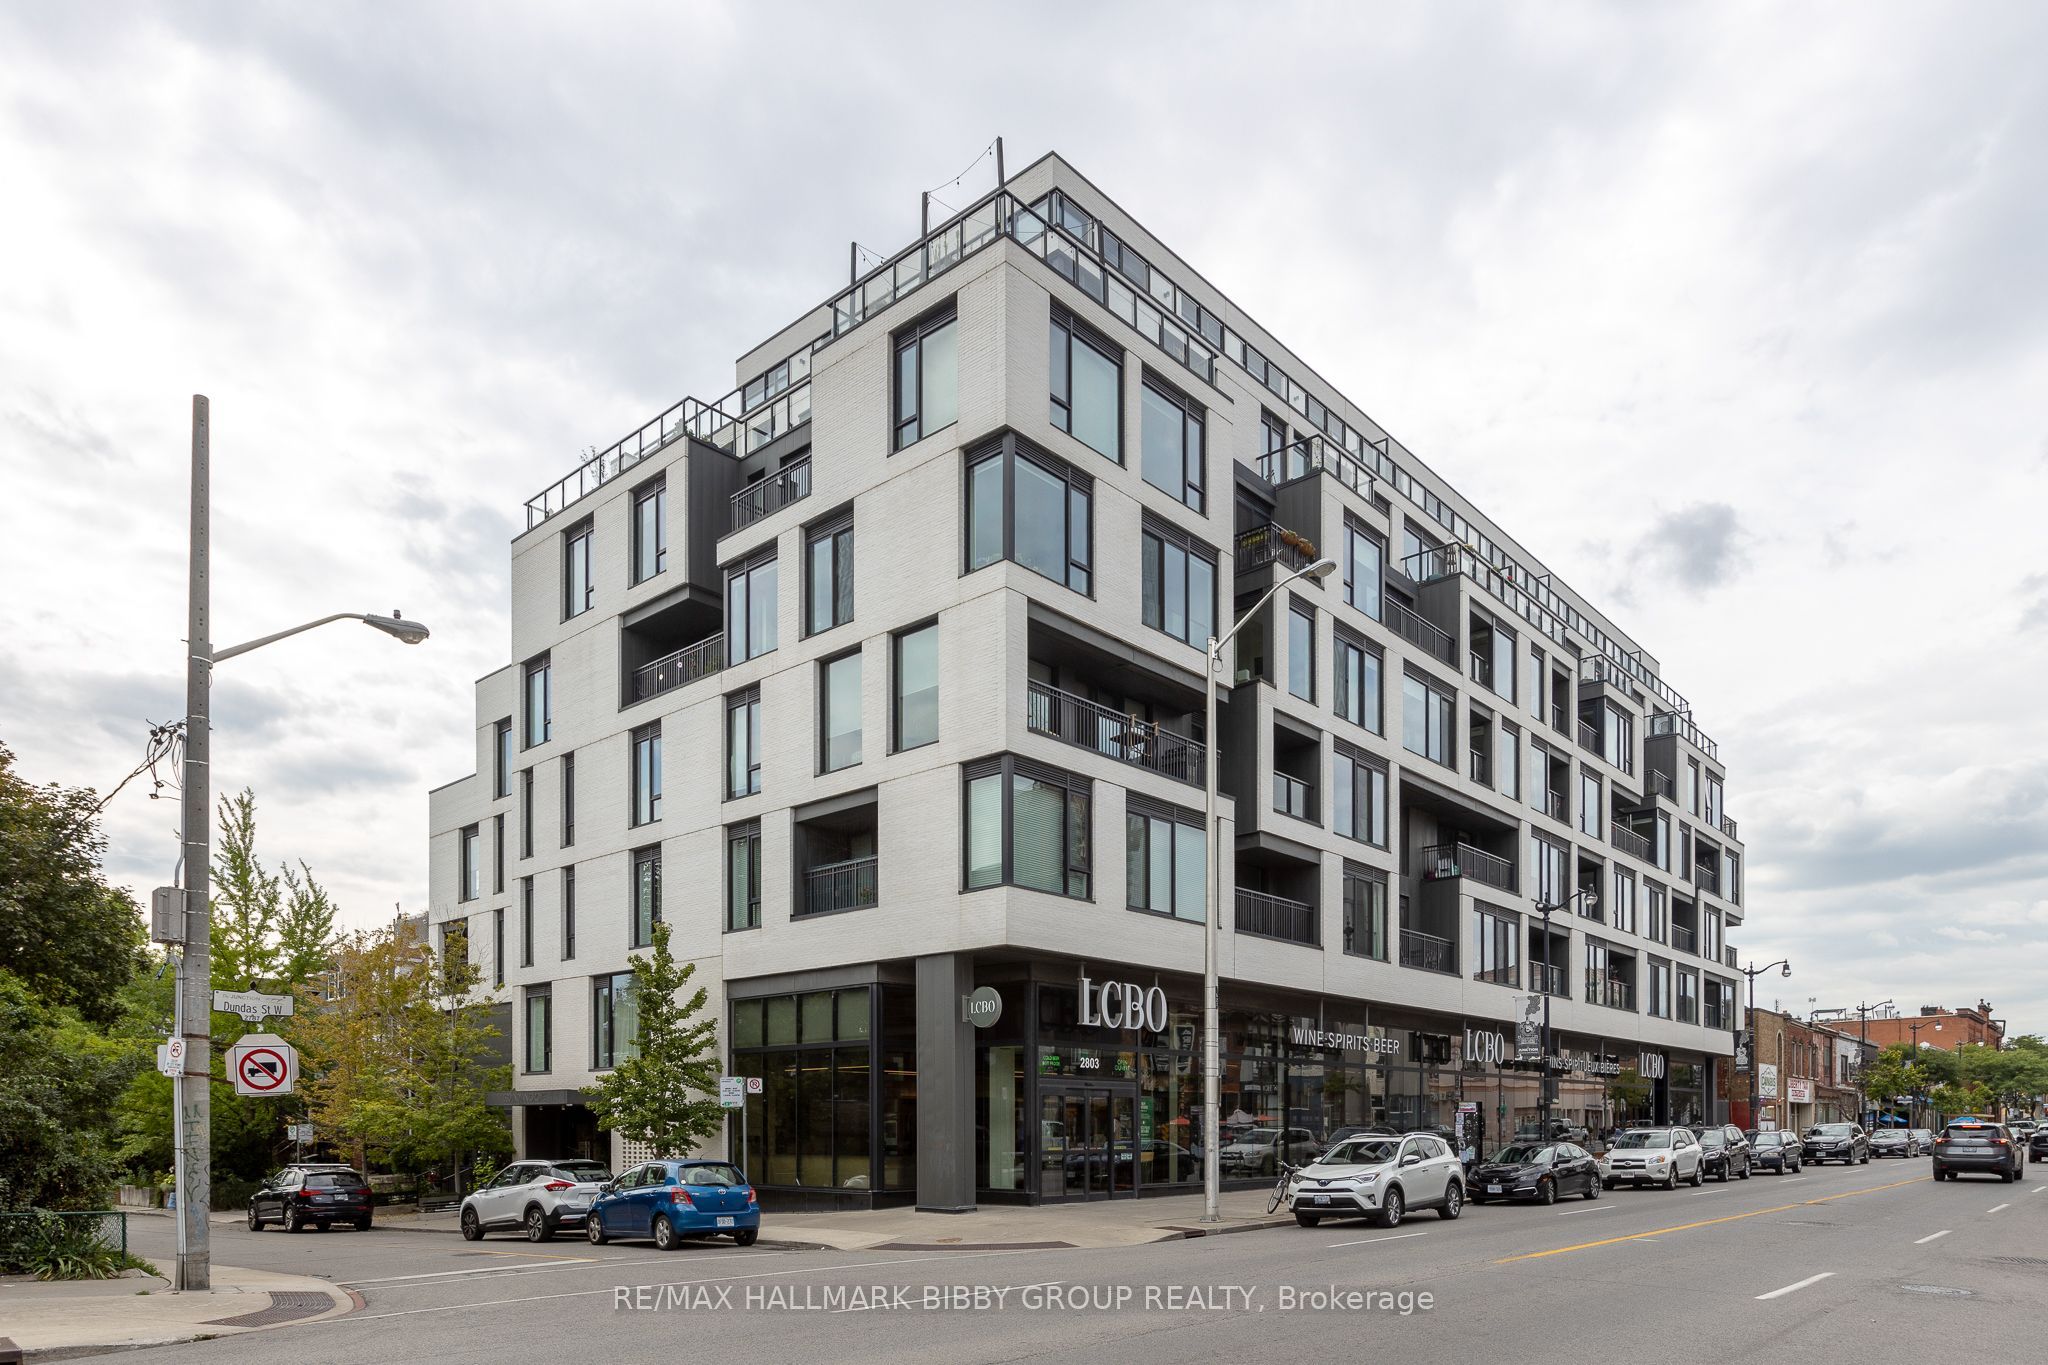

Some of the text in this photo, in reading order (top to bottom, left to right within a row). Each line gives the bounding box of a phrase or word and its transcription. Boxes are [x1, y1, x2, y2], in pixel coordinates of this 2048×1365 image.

[223, 1001, 283, 1015] Dundas St W
[970, 1000, 995, 1014] LCBO
[1077, 978, 1167, 1033] LCBO
[1466, 1028, 1505, 1065] LCBO
[1080, 1057, 1100, 1069] 2803
[1641, 1052, 1665, 1079] LCBO
